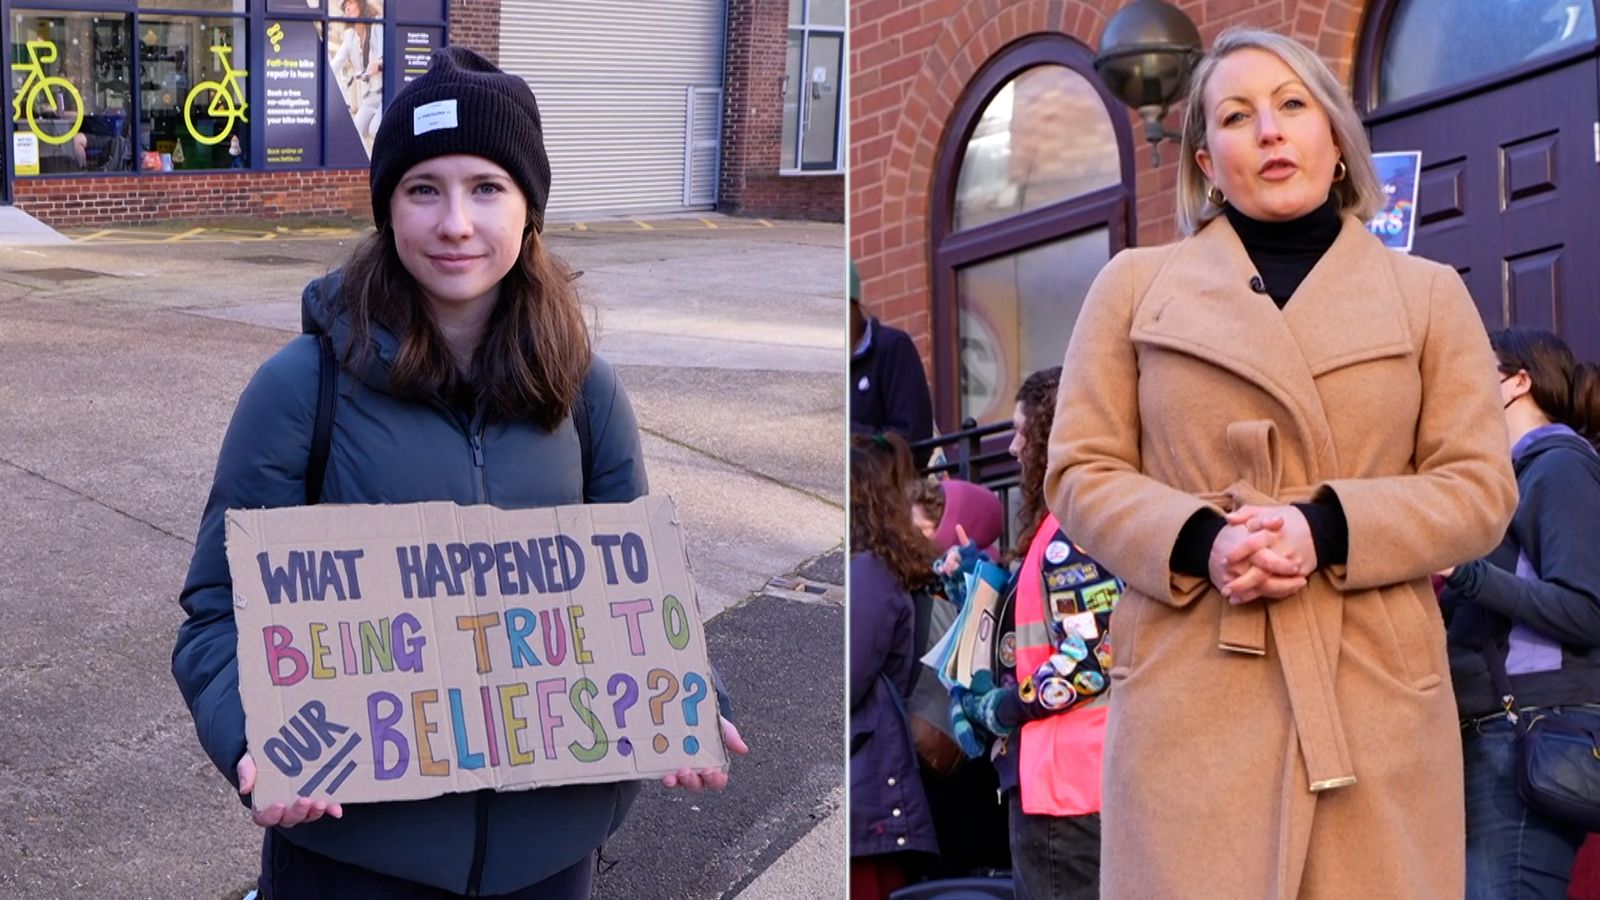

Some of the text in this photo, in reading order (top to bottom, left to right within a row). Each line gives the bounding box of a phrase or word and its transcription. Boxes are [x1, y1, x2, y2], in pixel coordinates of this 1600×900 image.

[266, 58, 314, 68] Faff-free bike
[266, 70, 314, 80] repair is here
[267, 89, 282, 97] Book
[289, 89, 301, 97] free
[267, 98, 310, 107] no-obligation
[267, 116, 316, 126] your bike today.
[257, 532, 649, 604] WHAT HAPPENED TO
[263, 594, 690, 686] BEING TRUE TO
[263, 671, 708, 780] OUR BELIEFS???
